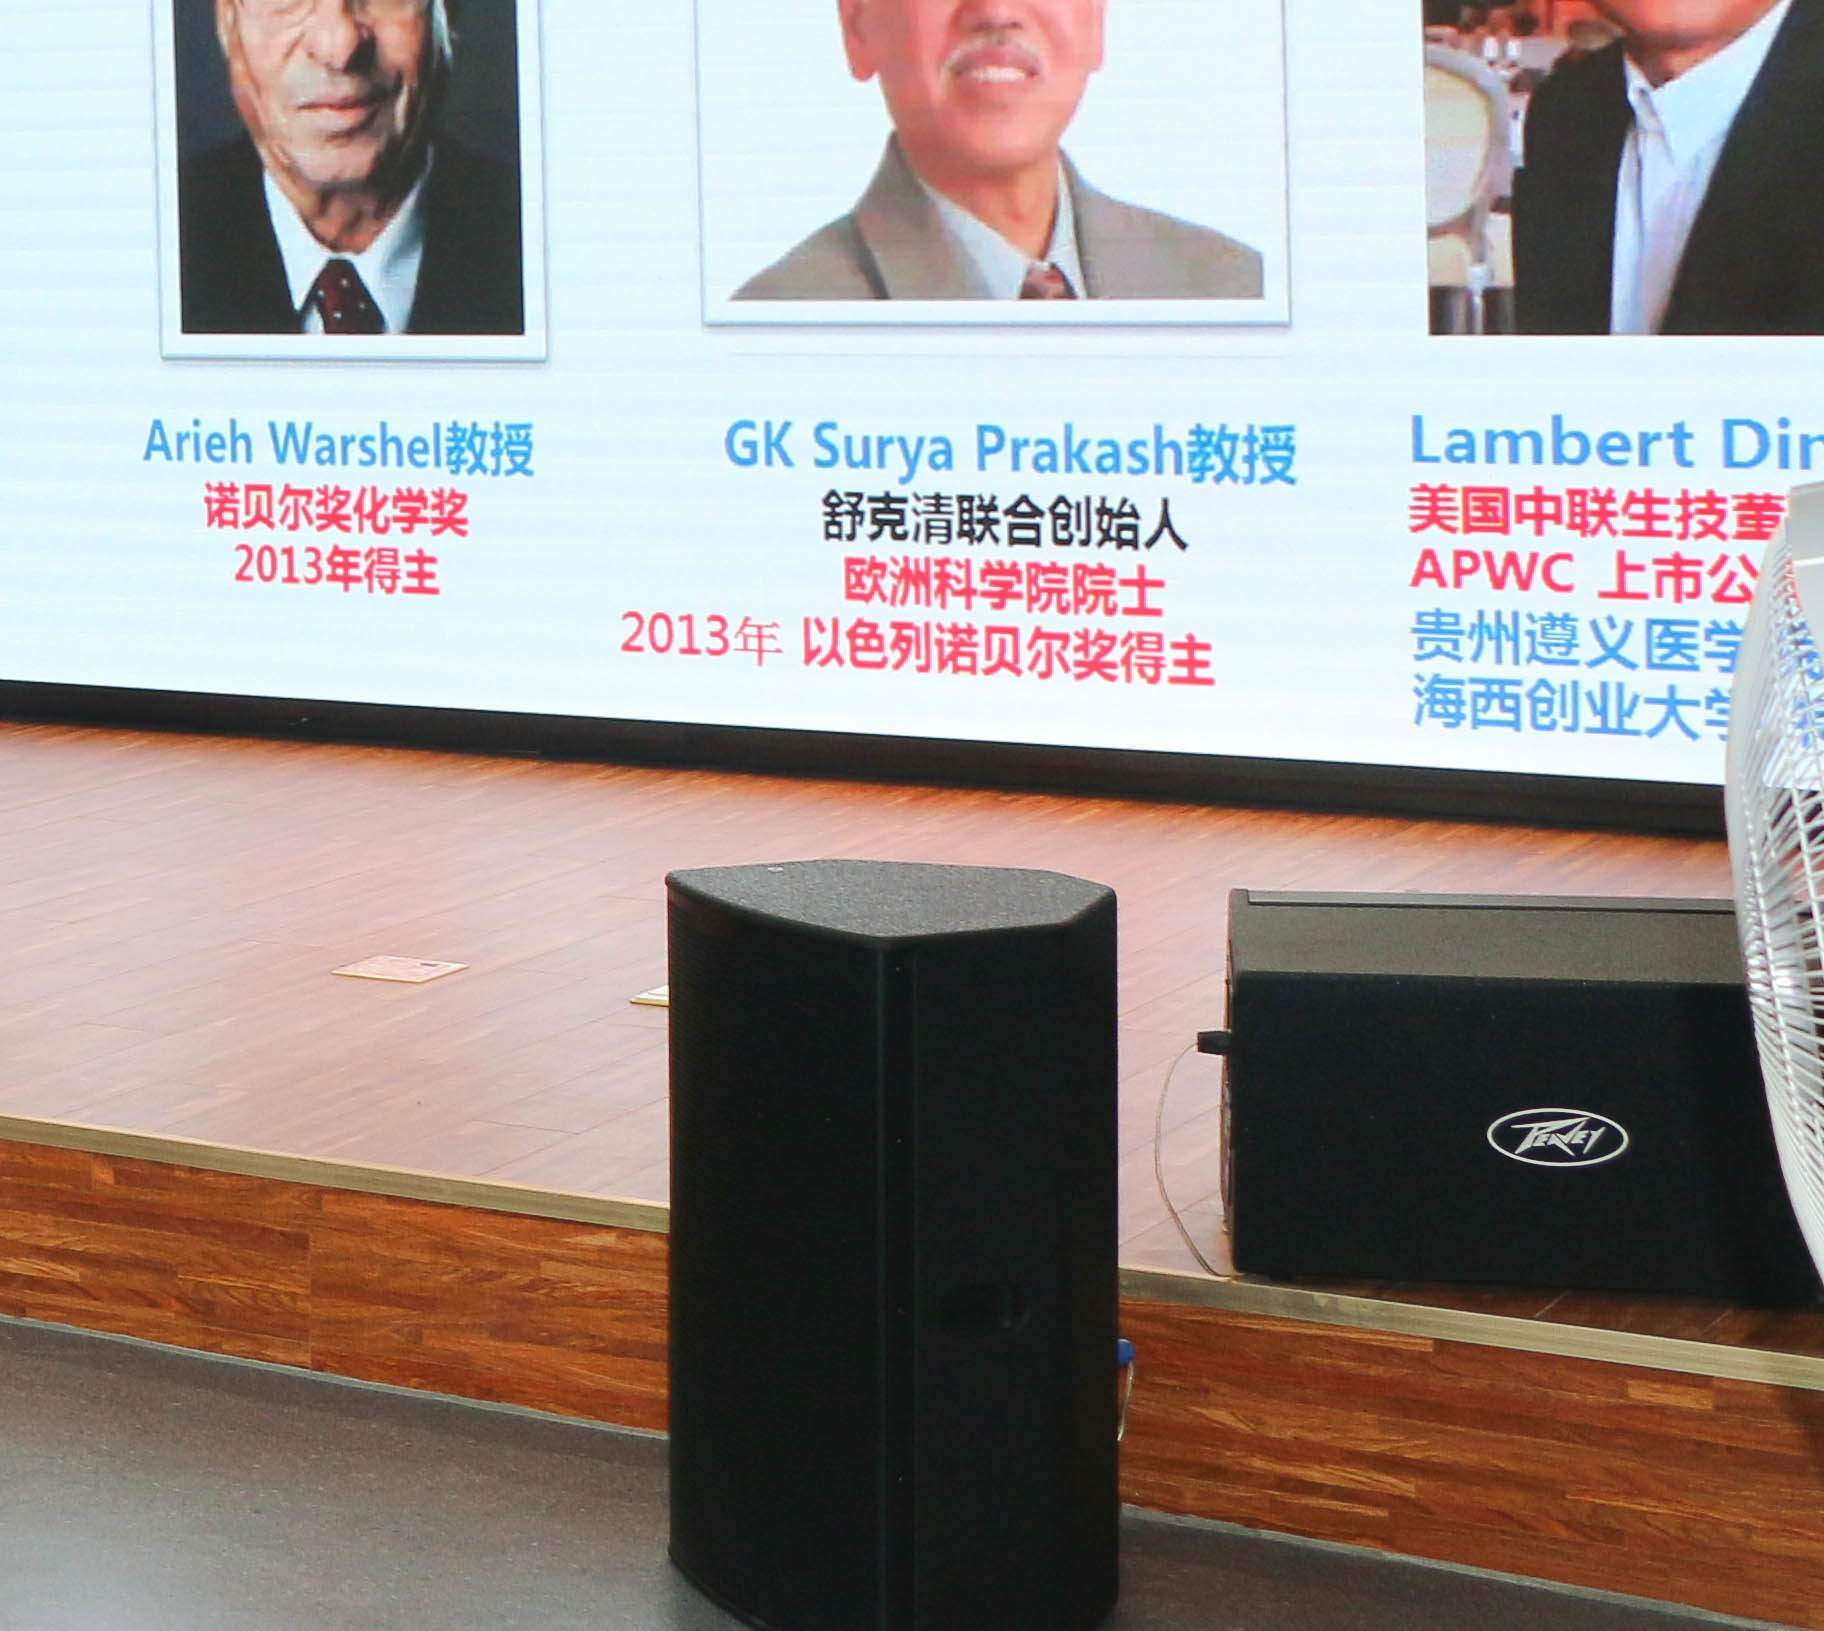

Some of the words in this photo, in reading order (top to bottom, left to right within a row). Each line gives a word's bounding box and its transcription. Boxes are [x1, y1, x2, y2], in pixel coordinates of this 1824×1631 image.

[143, 417, 253, 465] Arieh
[267, 420, 535, 477] Warshel教授
[725, 419, 795, 469] GK
[813, 420, 954, 485] Surya
[975, 422, 1298, 487] Prakash教授
[1410, 413, 1695, 468] Lambert
[203, 481, 470, 538] 诺贝尔奖化学奖
[821, 489, 1189, 551] 舒克清联合创始人
[1408, 482, 1787, 542] 美国中联生技董
[234, 543, 441, 596] 2013年得主
[843, 555, 1166, 618] 欧洲科学院院士
[1409, 547, 1575, 594] APWC
[1597, 549, 1761, 604] 上市公
[620, 611, 782, 667] 2013年
[801, 616, 1216, 687] 以色列诺贝尔奖得主
